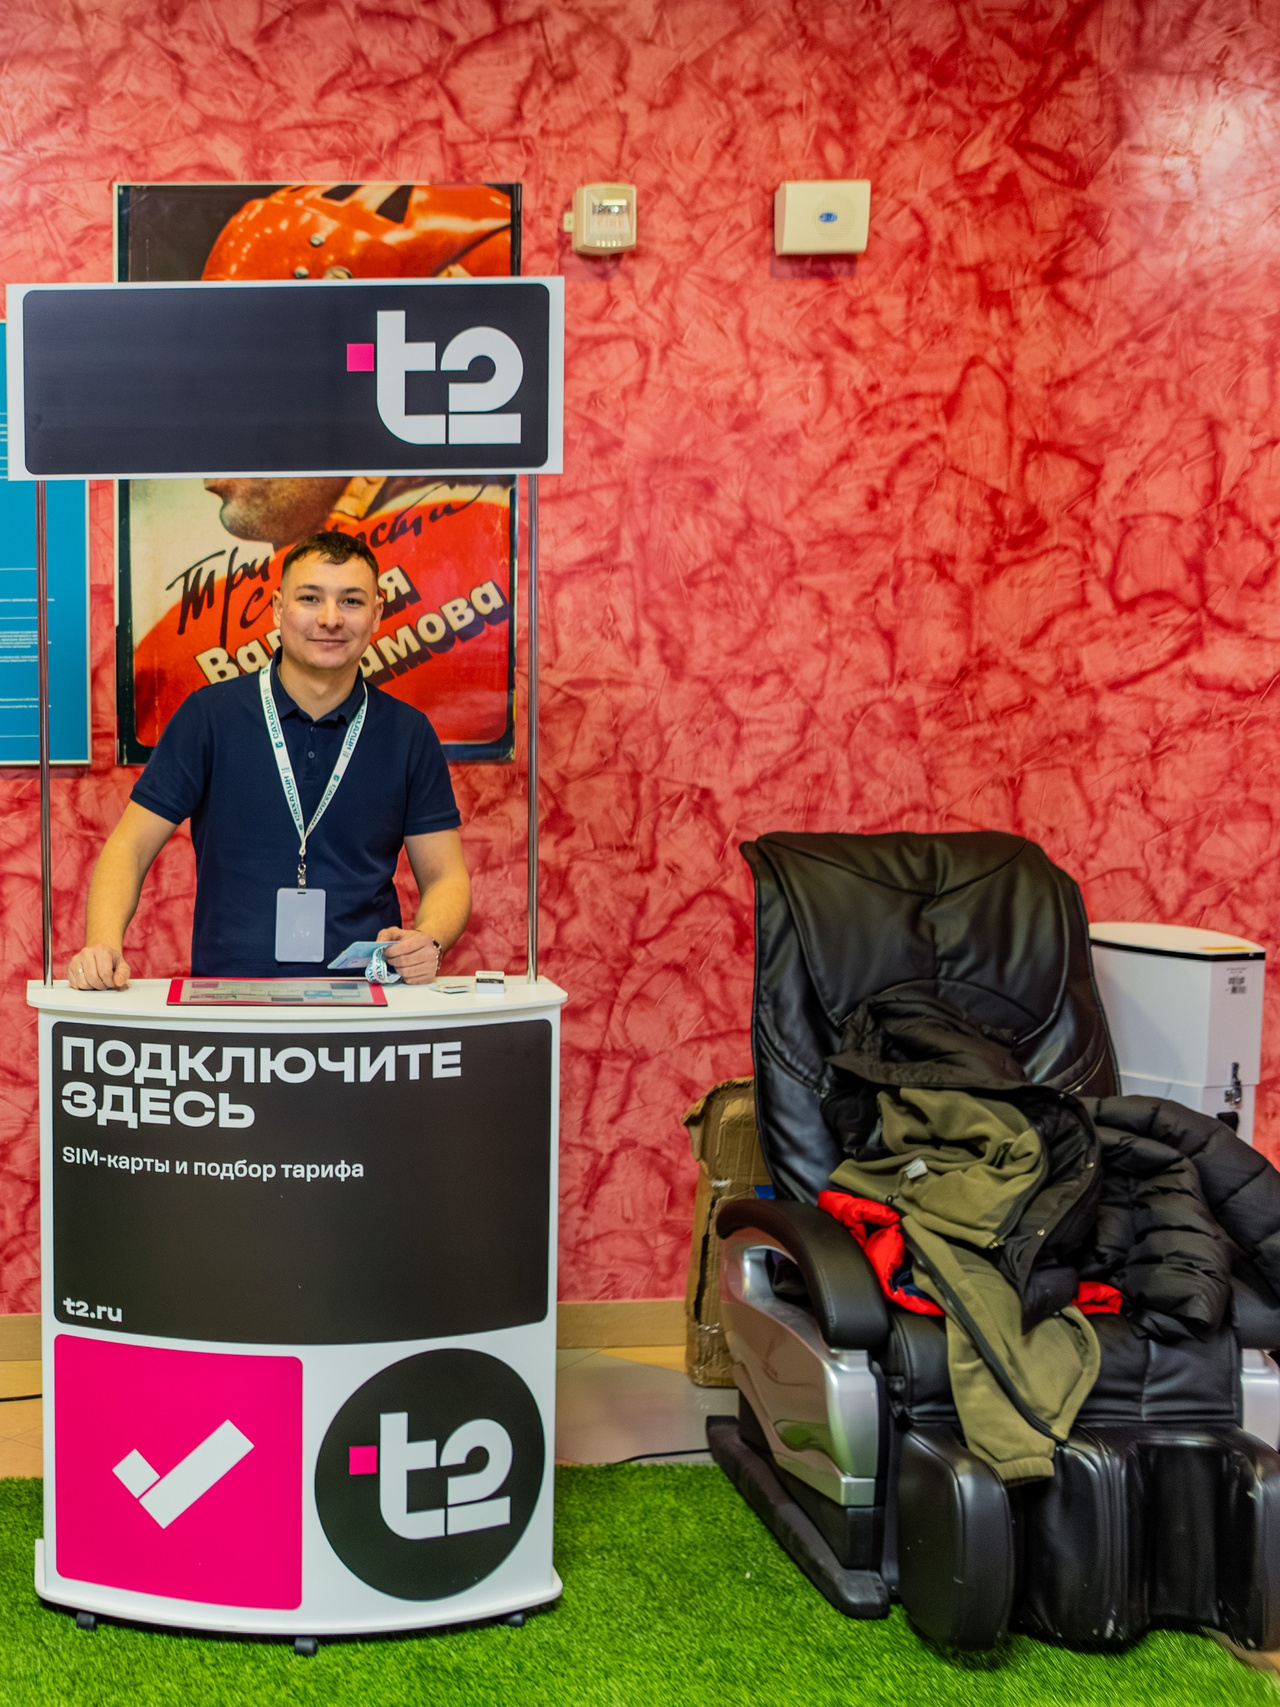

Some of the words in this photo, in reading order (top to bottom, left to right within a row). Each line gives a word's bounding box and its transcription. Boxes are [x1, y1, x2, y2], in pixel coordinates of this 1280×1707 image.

[377, 310, 523, 444] t2
[166, 546, 271, 650] Три
[61, 1036, 462, 1086] ПОДКЛЮЧИТЕ
[61, 1082, 256, 1129] ЗДЕСЬ
[62, 1146, 170, 1174] SIM-карты
[175, 1159, 189, 1175] и
[193, 1157, 276, 1181] подбор
[281, 1159, 365, 1182] тарифа
[62, 1297, 124, 1323] t2.ru
[380, 1411, 514, 1540] t2
